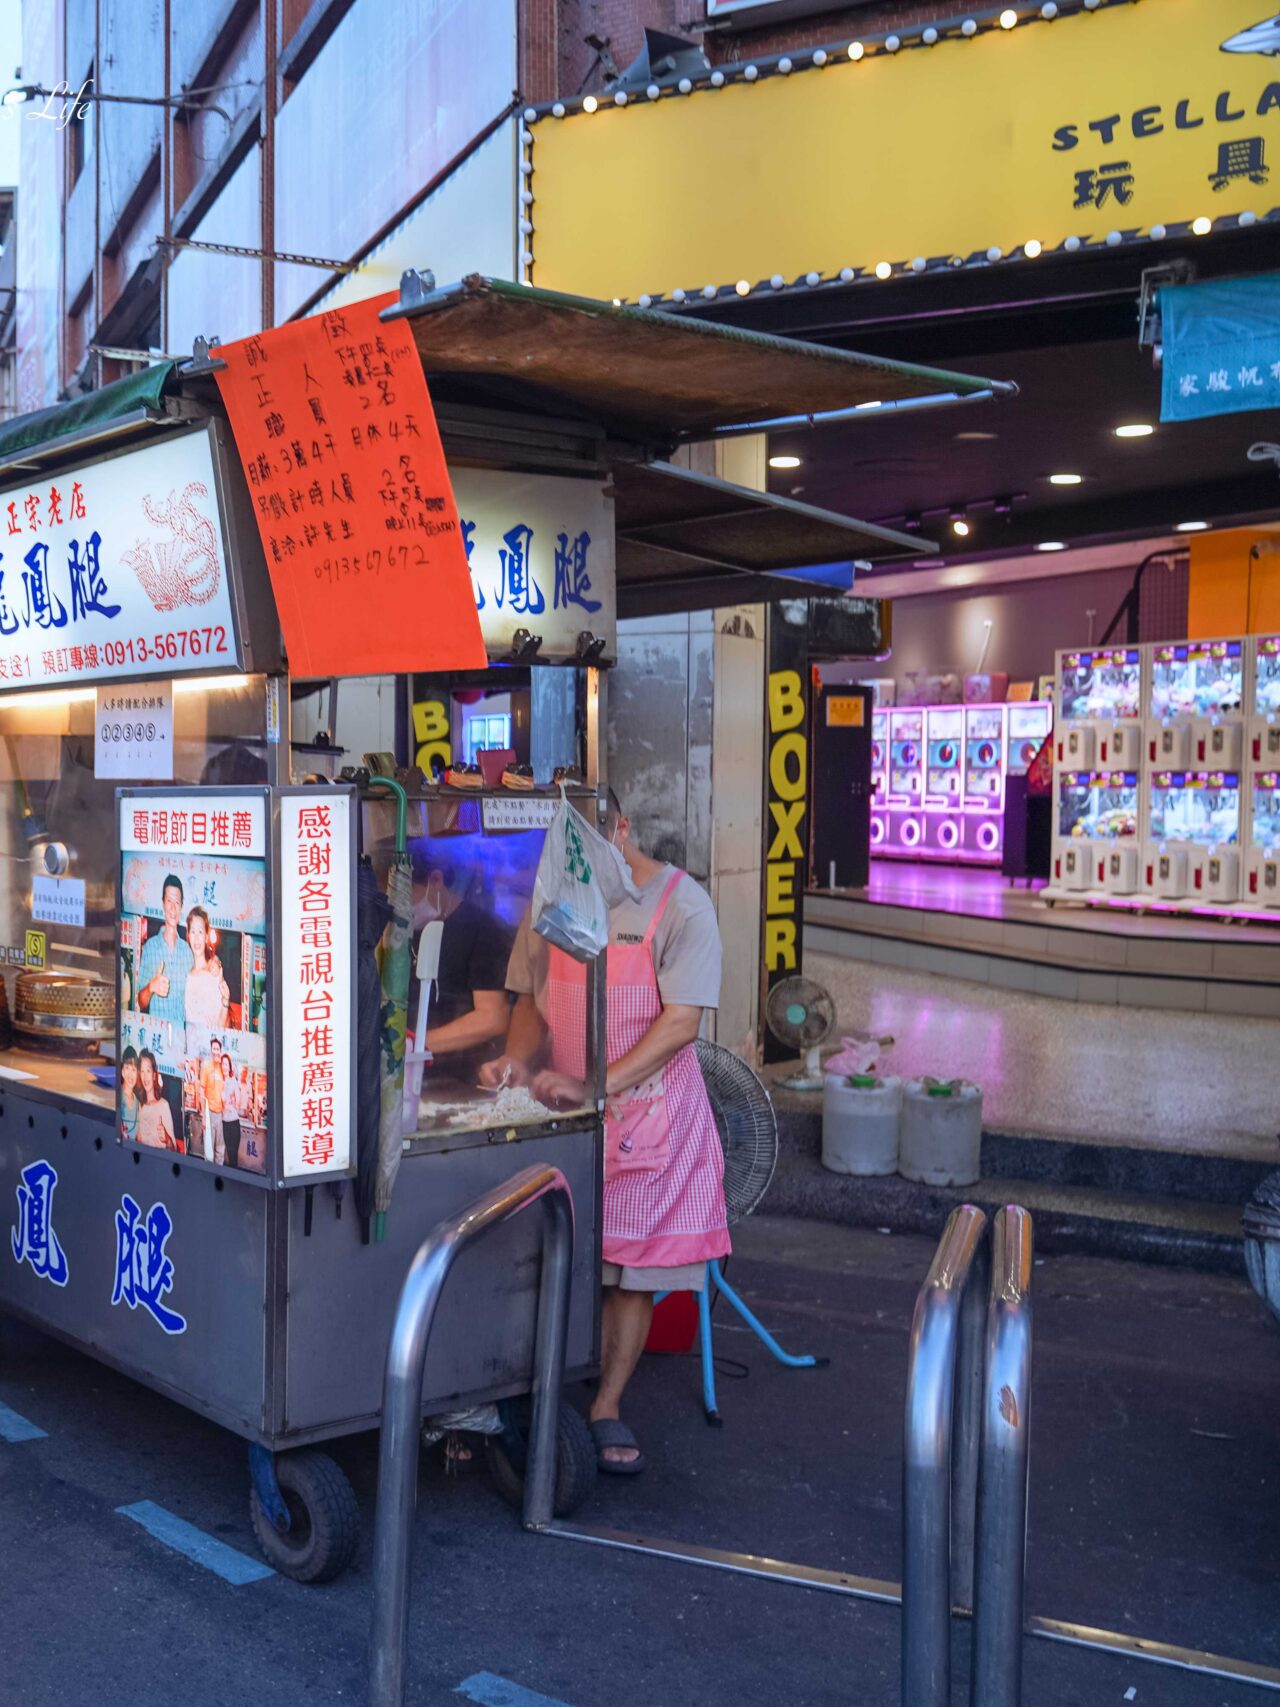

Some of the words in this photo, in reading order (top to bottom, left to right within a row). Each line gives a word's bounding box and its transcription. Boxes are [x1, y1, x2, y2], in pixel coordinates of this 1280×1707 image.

[1052, 81, 1280, 151] STELLA
[6, 481, 87, 536] 正宗老店
[132, 810, 253, 849] 電視節目推薦
[765, 669, 807, 972] BOXER
[297, 805, 336, 1165] 感謝各電視台推薦報導
